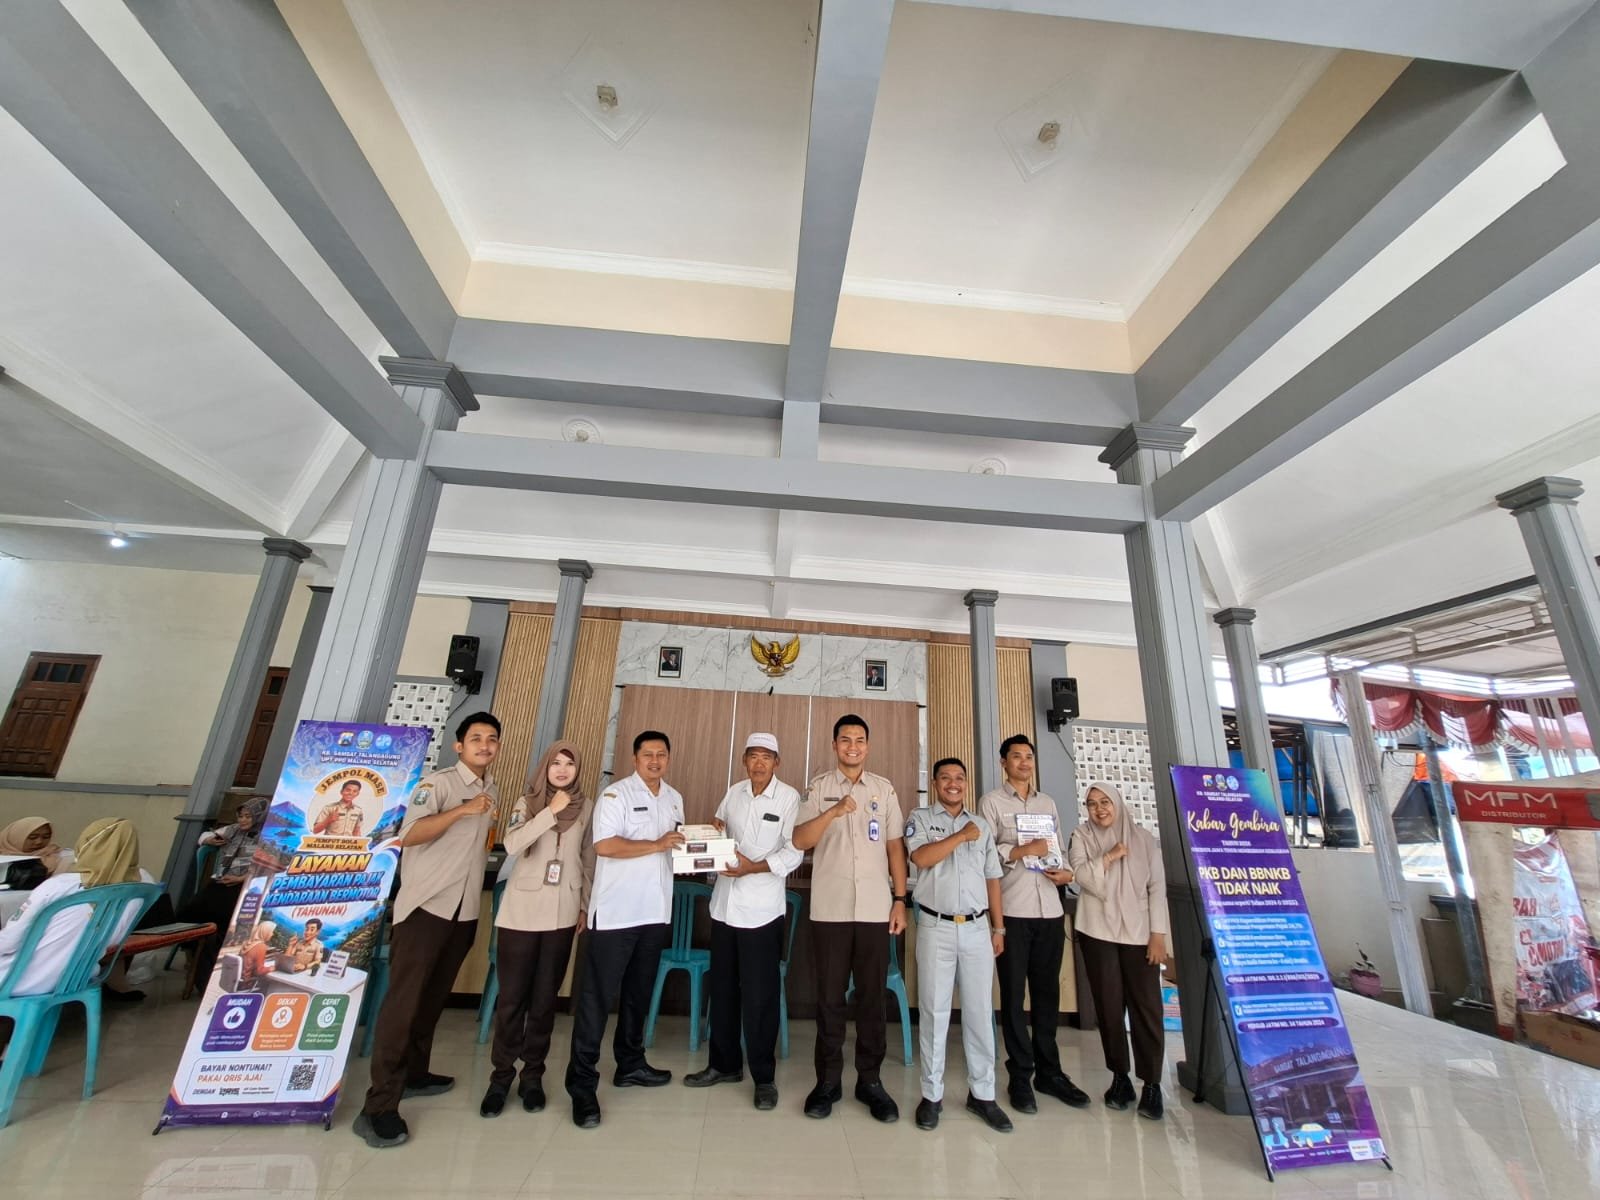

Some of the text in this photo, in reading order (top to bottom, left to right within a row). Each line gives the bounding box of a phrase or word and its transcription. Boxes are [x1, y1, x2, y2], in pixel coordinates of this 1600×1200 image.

[321, 769, 385, 795] JEMPOL MASE
[1463, 789, 1558, 809] MFM
[1481, 810, 1547, 819] DISTRIBUTOR
[1187, 807, 1280, 839] Kabar Gembira
[287, 853, 373, 875] LAYANAN
[1198, 867, 1291, 880] PKB DAN BBNKB
[270, 873, 352, 892] PEMBAYARAN
[1214, 882, 1282, 895] TIDAK NAIK
[262, 887, 381, 908] KENDARAAN BERMOTOR
[291, 904, 348, 918] (TAHUNAN)
[226, 998, 253, 1006] MUDAH
[276, 998, 298, 1006] DEKAT
[321, 998, 341, 1006] CEPAT
[200, 1063, 273, 1072] BAYAR NONTUNAI?
[197, 1074, 221, 1083] PAKAI
[223, 1074, 242, 1082] QRIS
